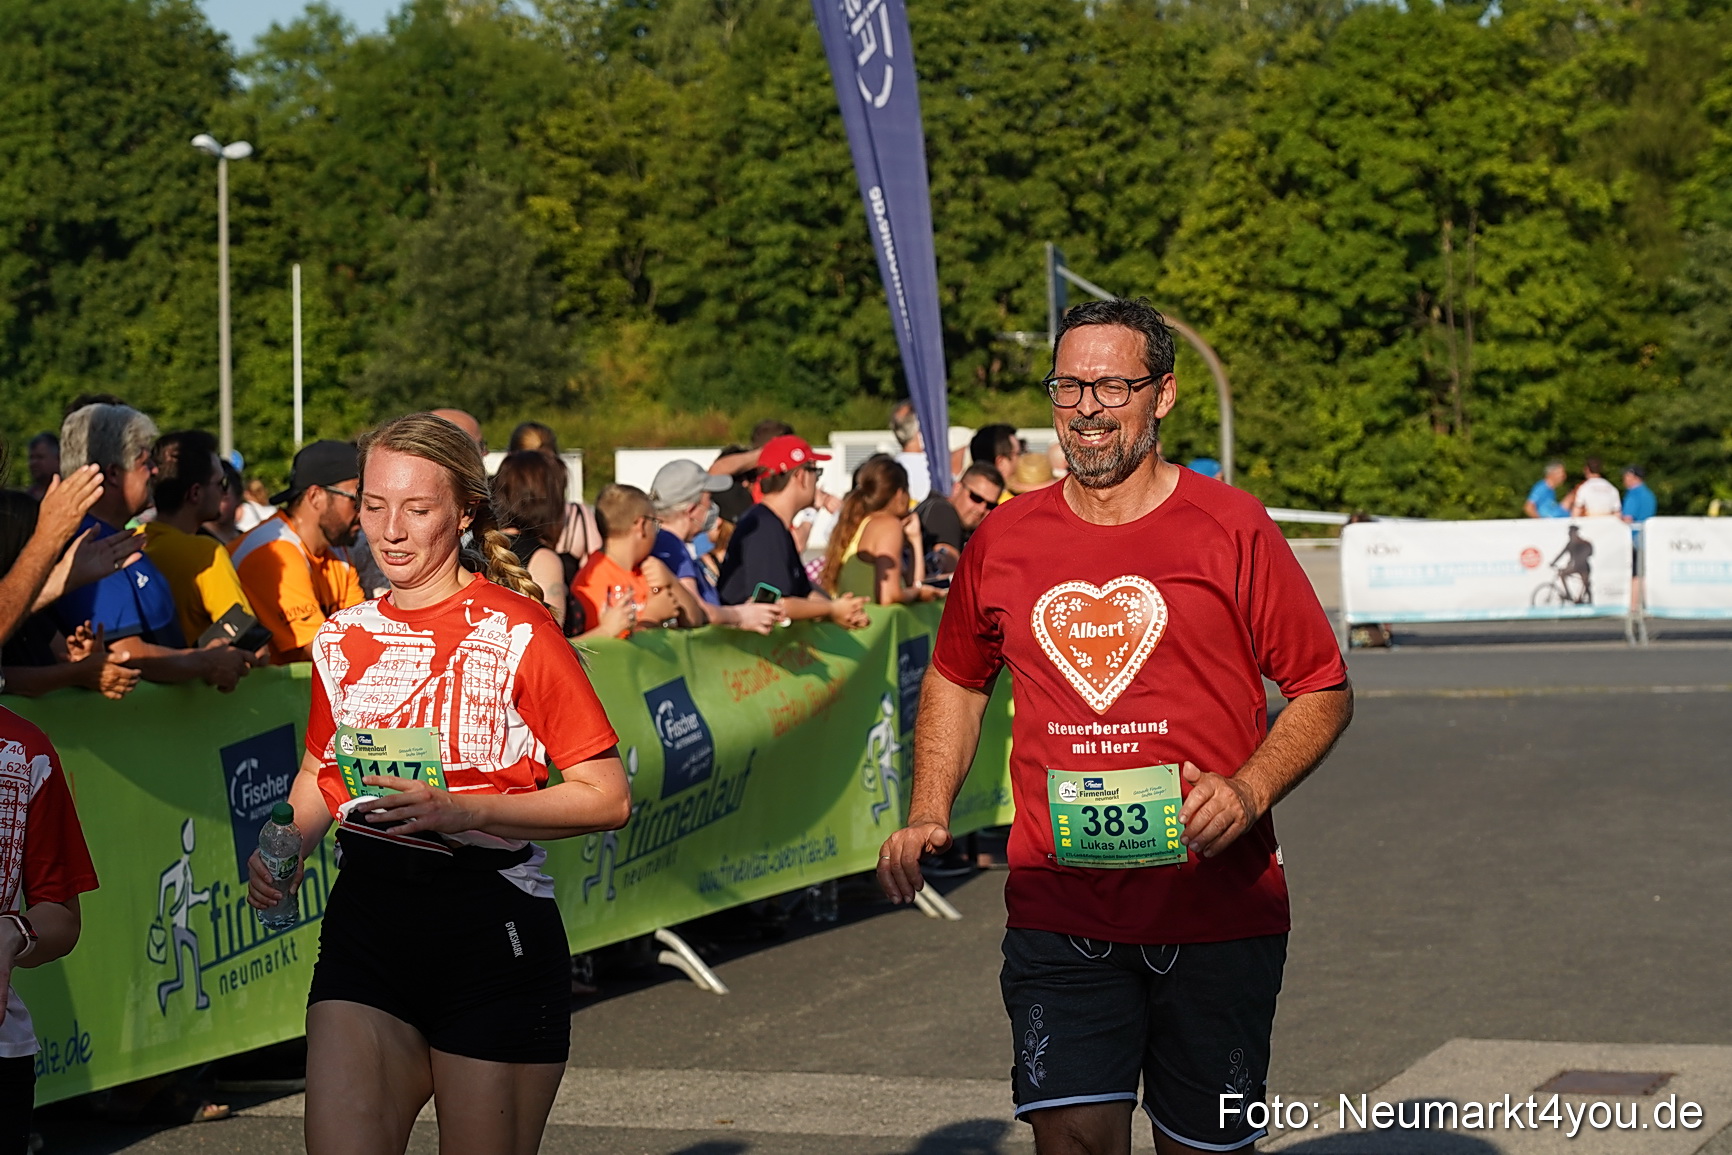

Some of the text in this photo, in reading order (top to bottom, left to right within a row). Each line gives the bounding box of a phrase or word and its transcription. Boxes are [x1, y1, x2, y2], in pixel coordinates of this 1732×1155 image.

[1068, 620, 1125, 639] Albert
[1048, 720, 1168, 735] Steuerberatung
[1072, 741, 1139, 754] mit Herz
[352, 759, 422, 789] 1117
[425, 766, 440, 787] 22
[241, 773, 290, 810] Fischer
[1079, 788, 1120, 798] Firmenlauf
[1058, 815, 1072, 848] RUN
[1081, 803, 1149, 837] 383
[1164, 804, 1180, 850] 2022
[1080, 837, 1157, 851] Lukas Albert
[504, 921, 523, 958] GYMSHARK
[219, 936, 298, 995] neumarkt
